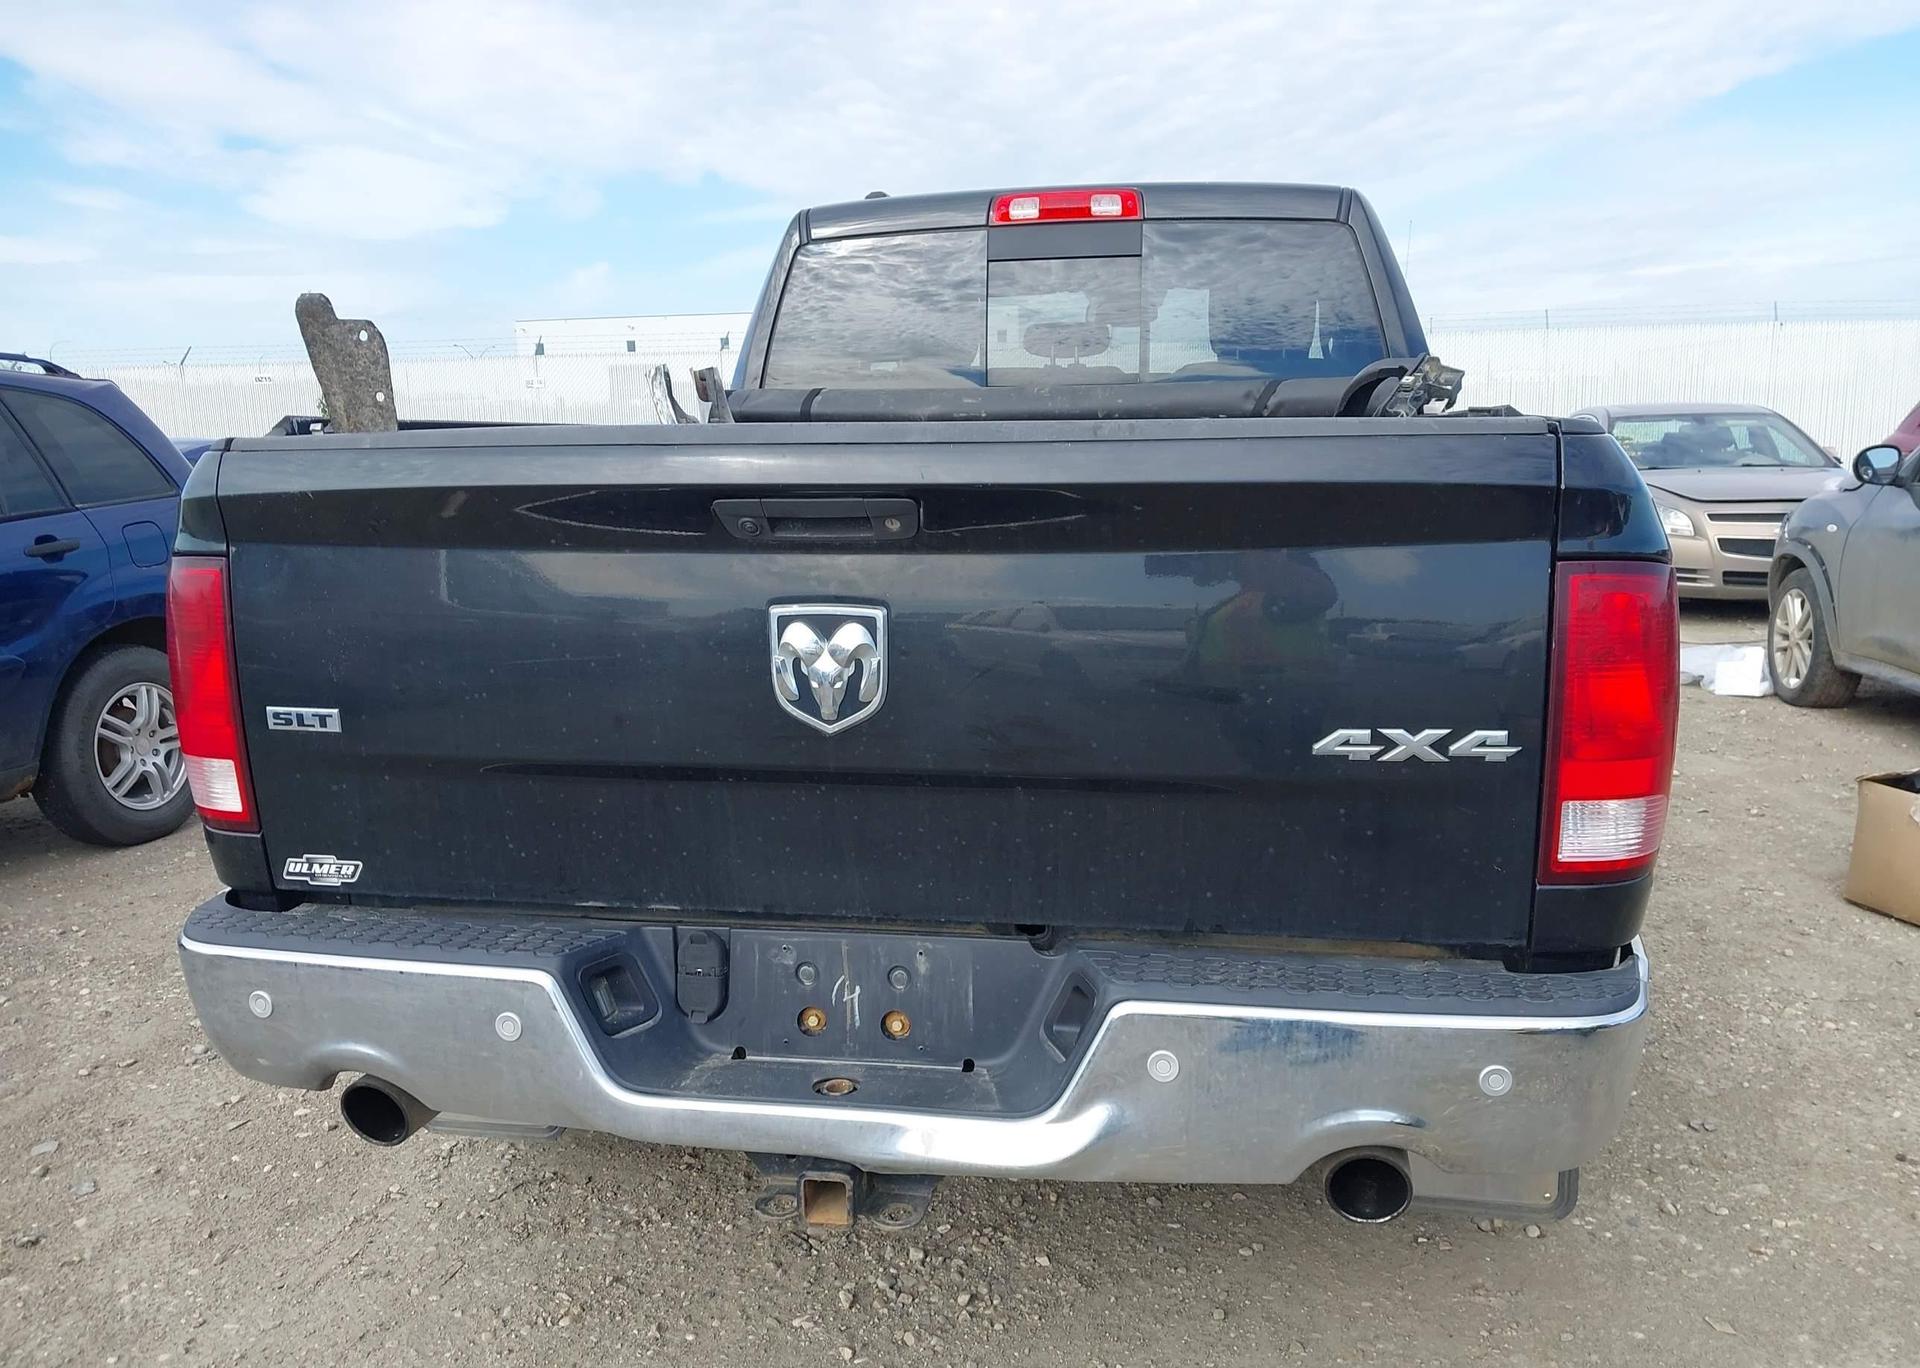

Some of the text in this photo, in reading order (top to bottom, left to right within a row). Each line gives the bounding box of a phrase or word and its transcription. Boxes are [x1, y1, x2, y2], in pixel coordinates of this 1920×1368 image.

[272, 712, 333, 729] SLT
[1312, 728, 1522, 762] 4X4
[288, 862, 355, 876] ULMER
